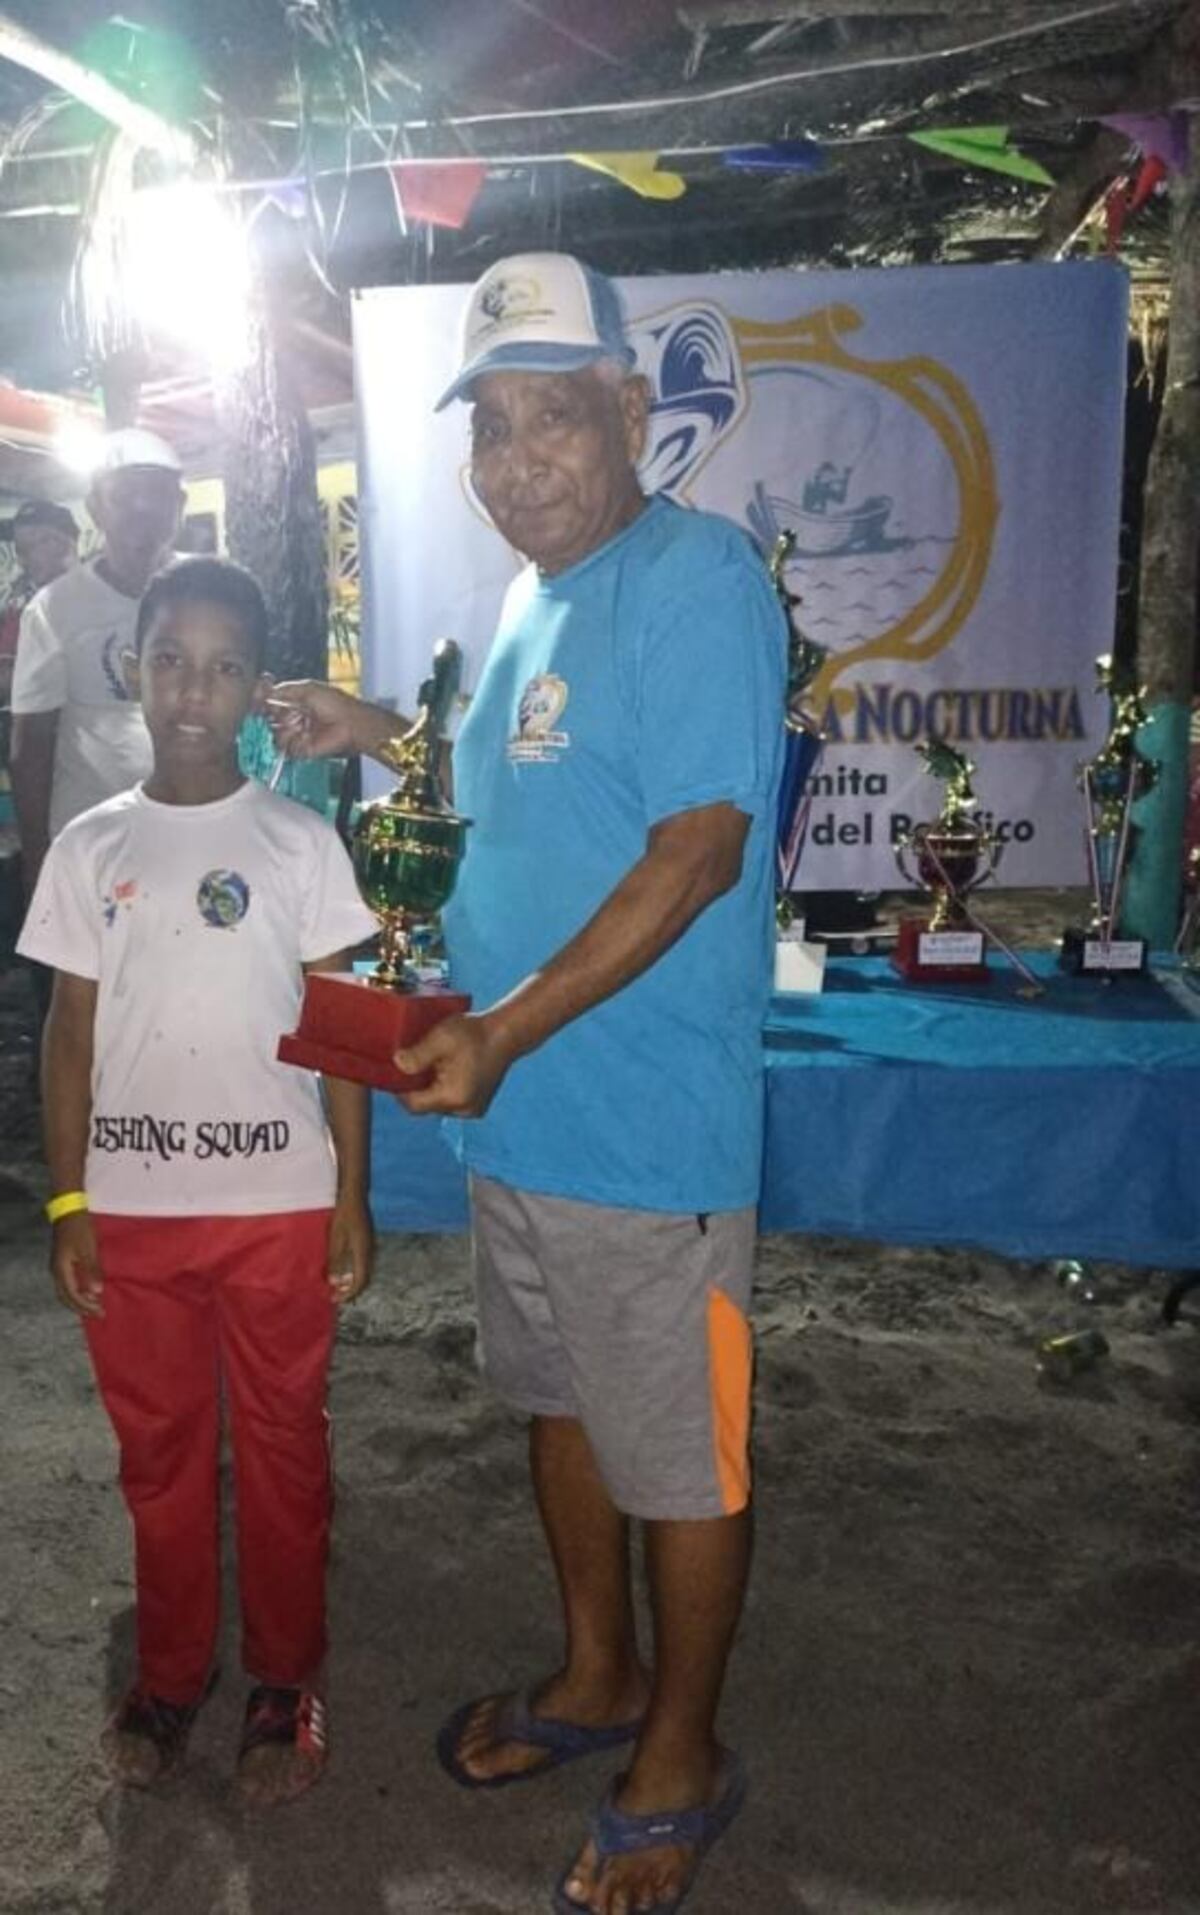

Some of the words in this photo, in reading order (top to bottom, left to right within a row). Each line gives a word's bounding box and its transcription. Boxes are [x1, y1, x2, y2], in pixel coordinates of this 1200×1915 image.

[855, 682, 1087, 743] NOCTURNA
[806, 765, 887, 796] mita
[812, 812, 872, 846] del
[94, 1114, 186, 1161] ISHING
[194, 1120, 290, 1159] SQUAD
